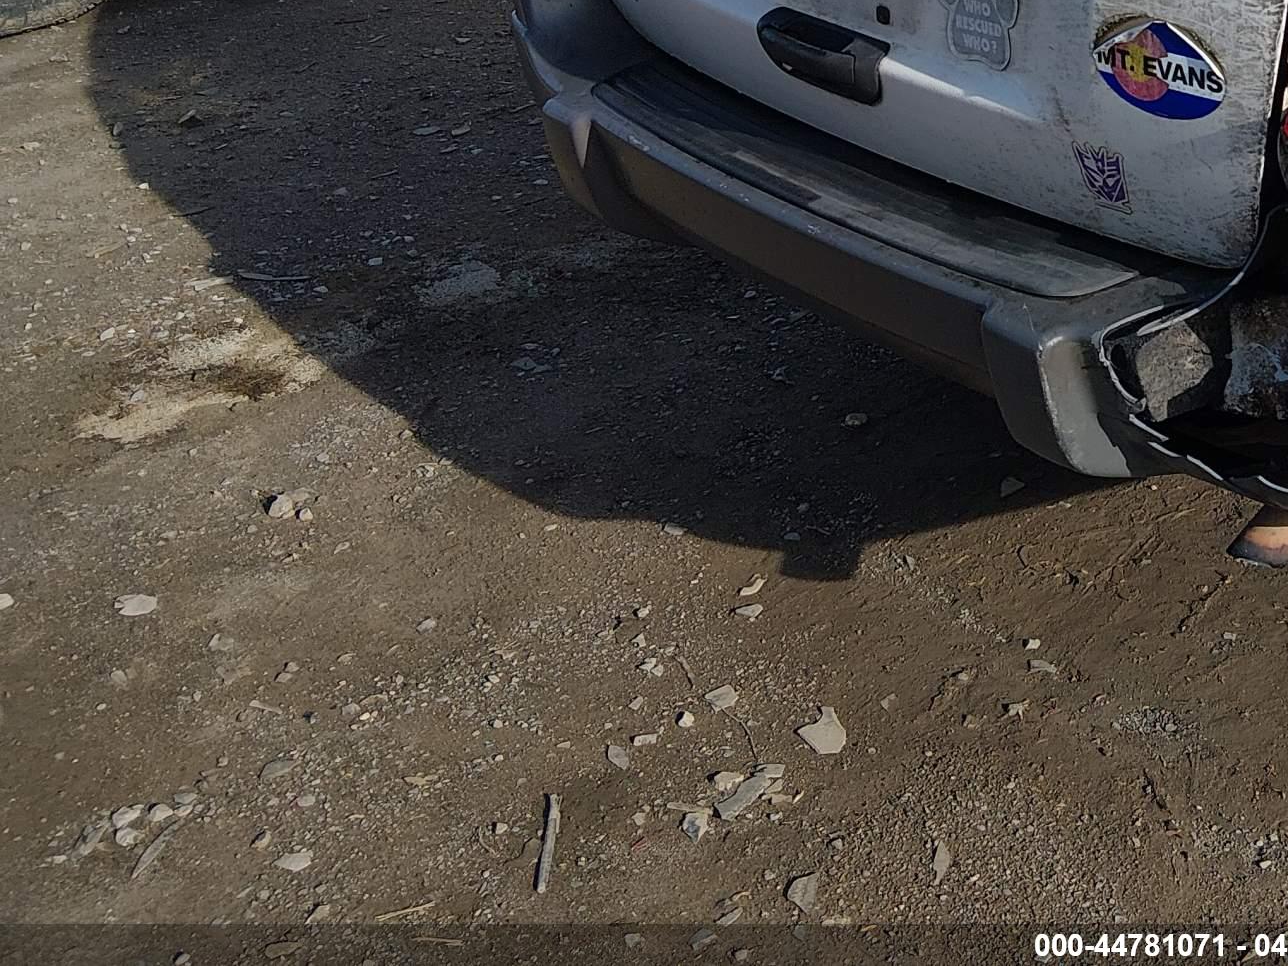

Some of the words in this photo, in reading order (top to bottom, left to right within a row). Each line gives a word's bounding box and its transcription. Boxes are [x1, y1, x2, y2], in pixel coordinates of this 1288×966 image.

[955, 14, 1002, 38] RESCUED
[961, 33, 997, 54] WHO?
[1096, 46, 1135, 71] MT.
[1143, 55, 1223, 94] EVANS
